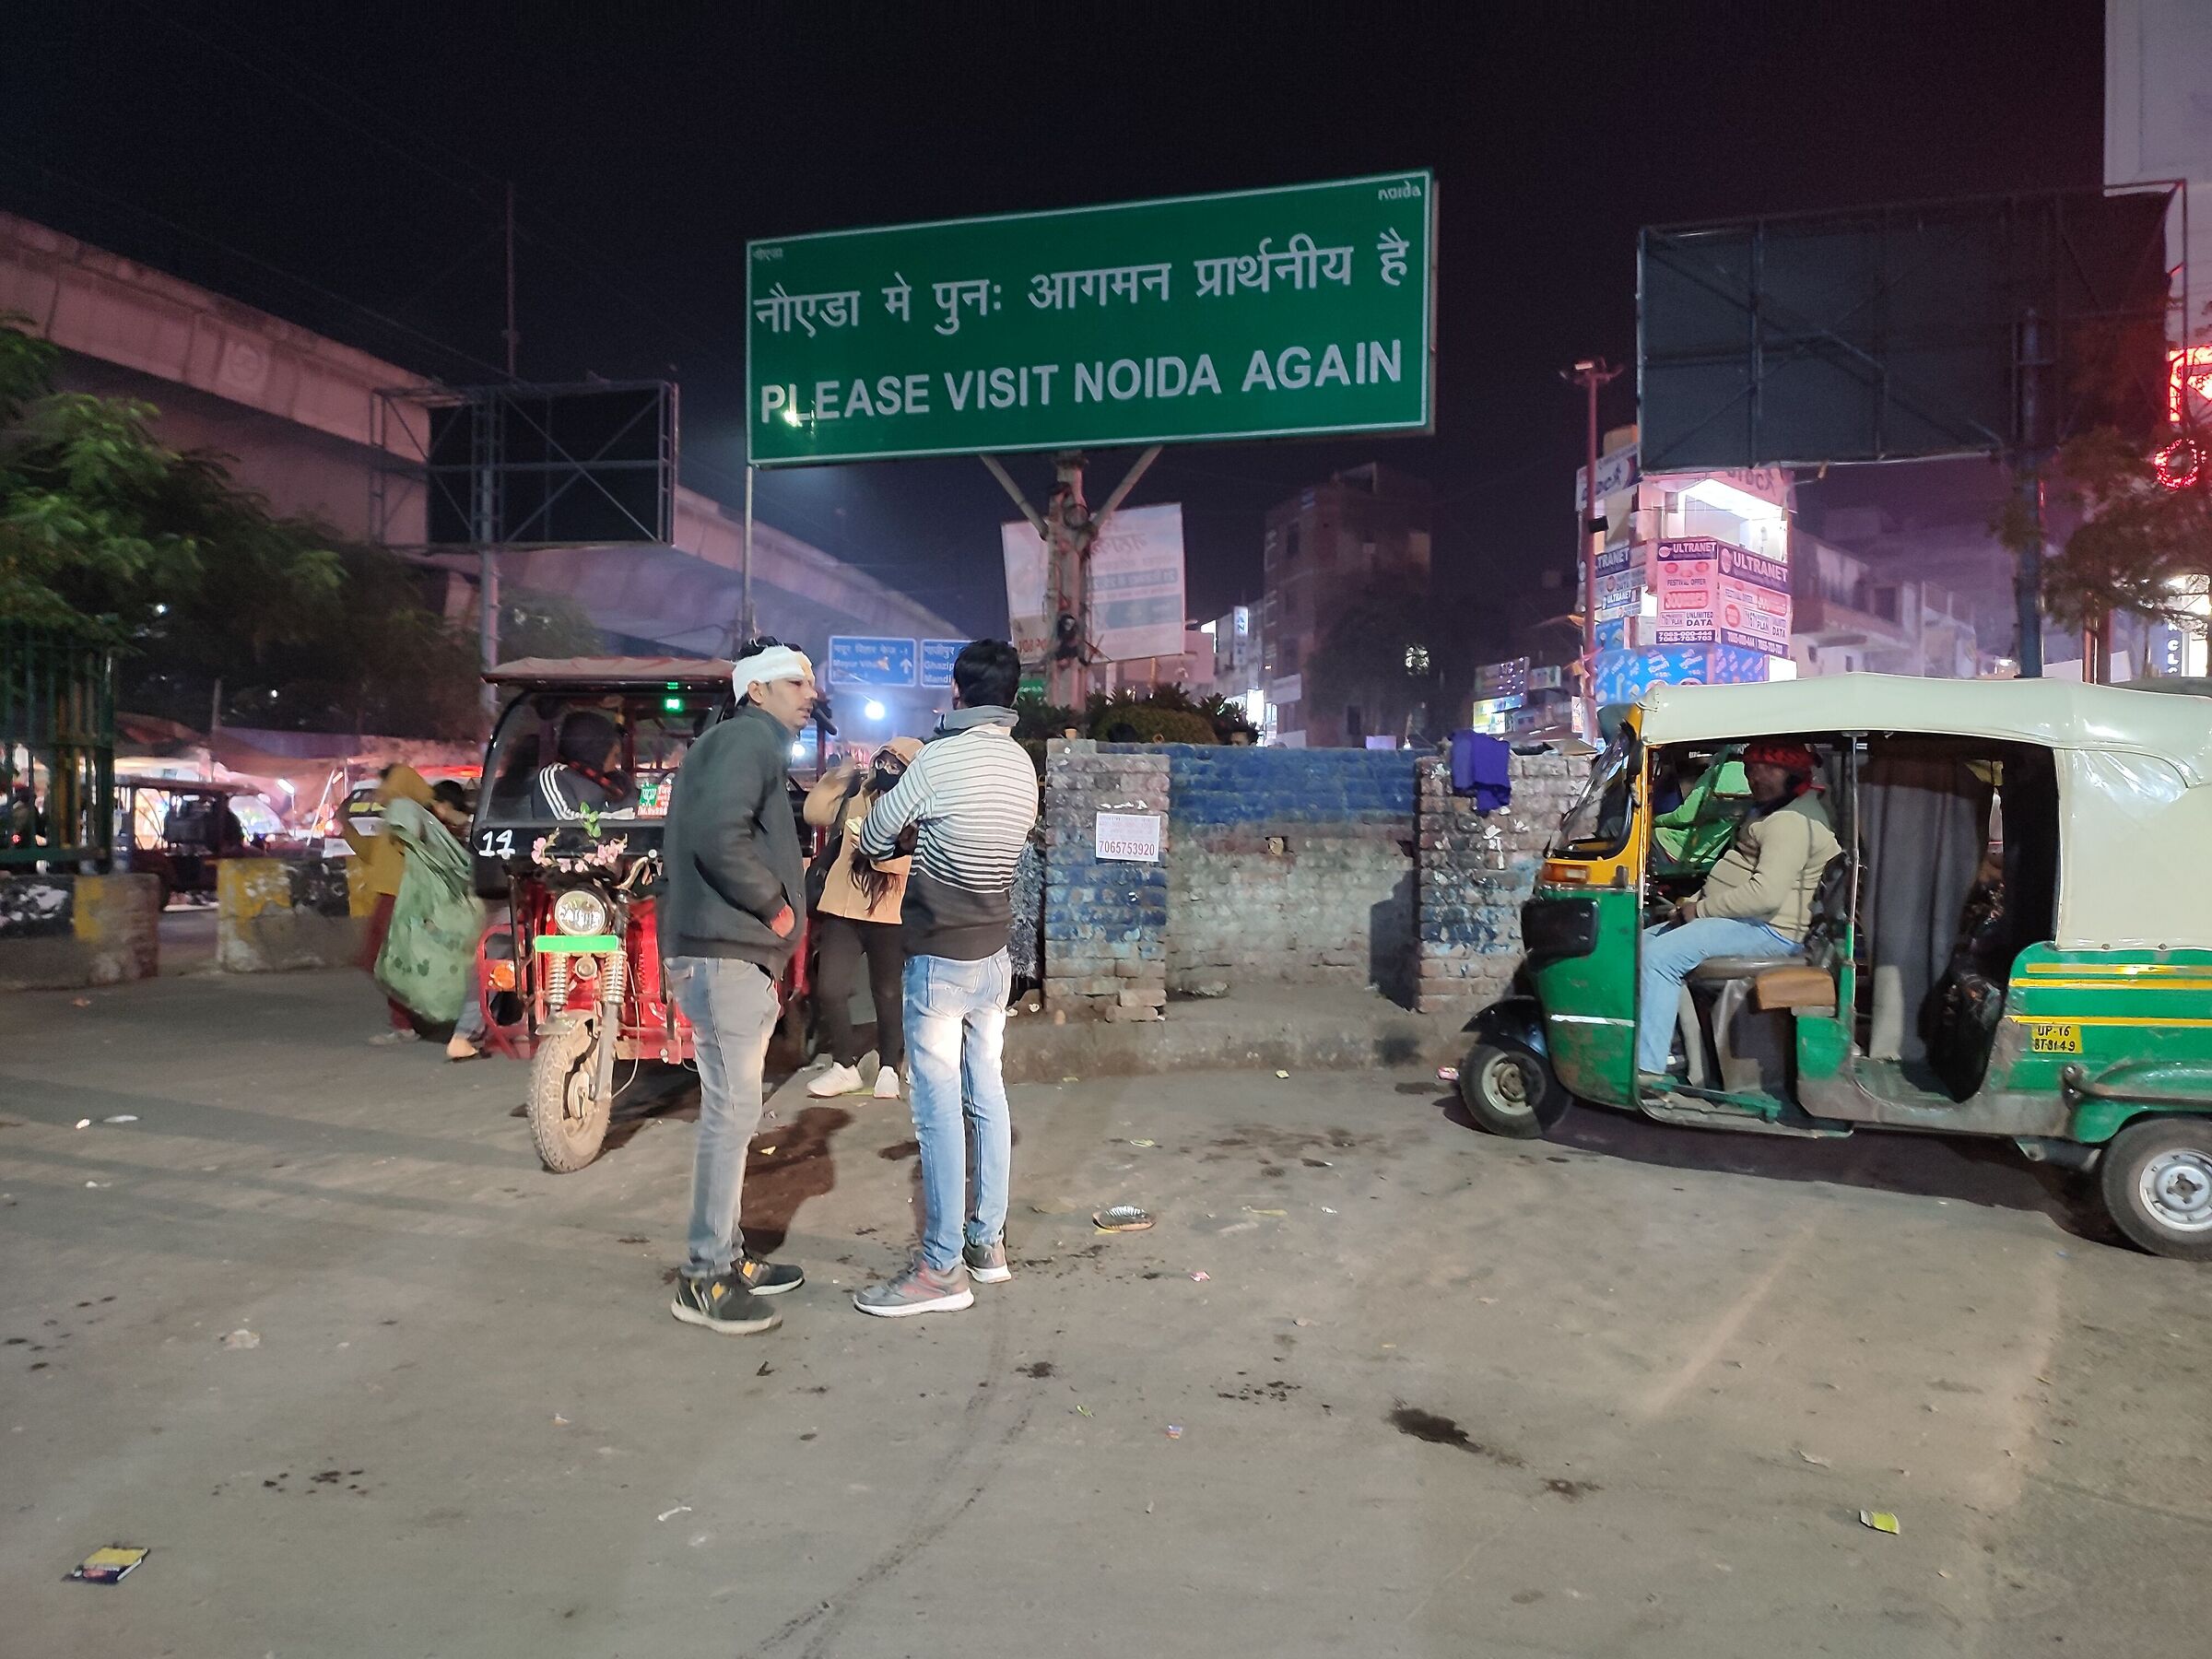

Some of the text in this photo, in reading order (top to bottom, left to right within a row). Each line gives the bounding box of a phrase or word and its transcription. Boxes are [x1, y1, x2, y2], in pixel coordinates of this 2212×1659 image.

[753, 281, 861, 338] नौएडा
[881, 271, 912, 322] मे
[1028, 263, 1172, 310] आगमन
[1194, 232, 1355, 297] प्रार्थनीय
[1377, 227, 1410, 287] है
[761, 339, 1402, 424] PLEASE VISIT NOIDA AGAIN
[1673, 542, 1717, 553] ULTRANET
[1733, 550, 1788, 582] ULTRANET
[1606, 590, 1631, 604] ULTRANET
[1771, 626, 1786, 638] DATA
[1099, 840, 1155, 856] 7065753920
[2037, 1025, 2071, 1037] UP-16
